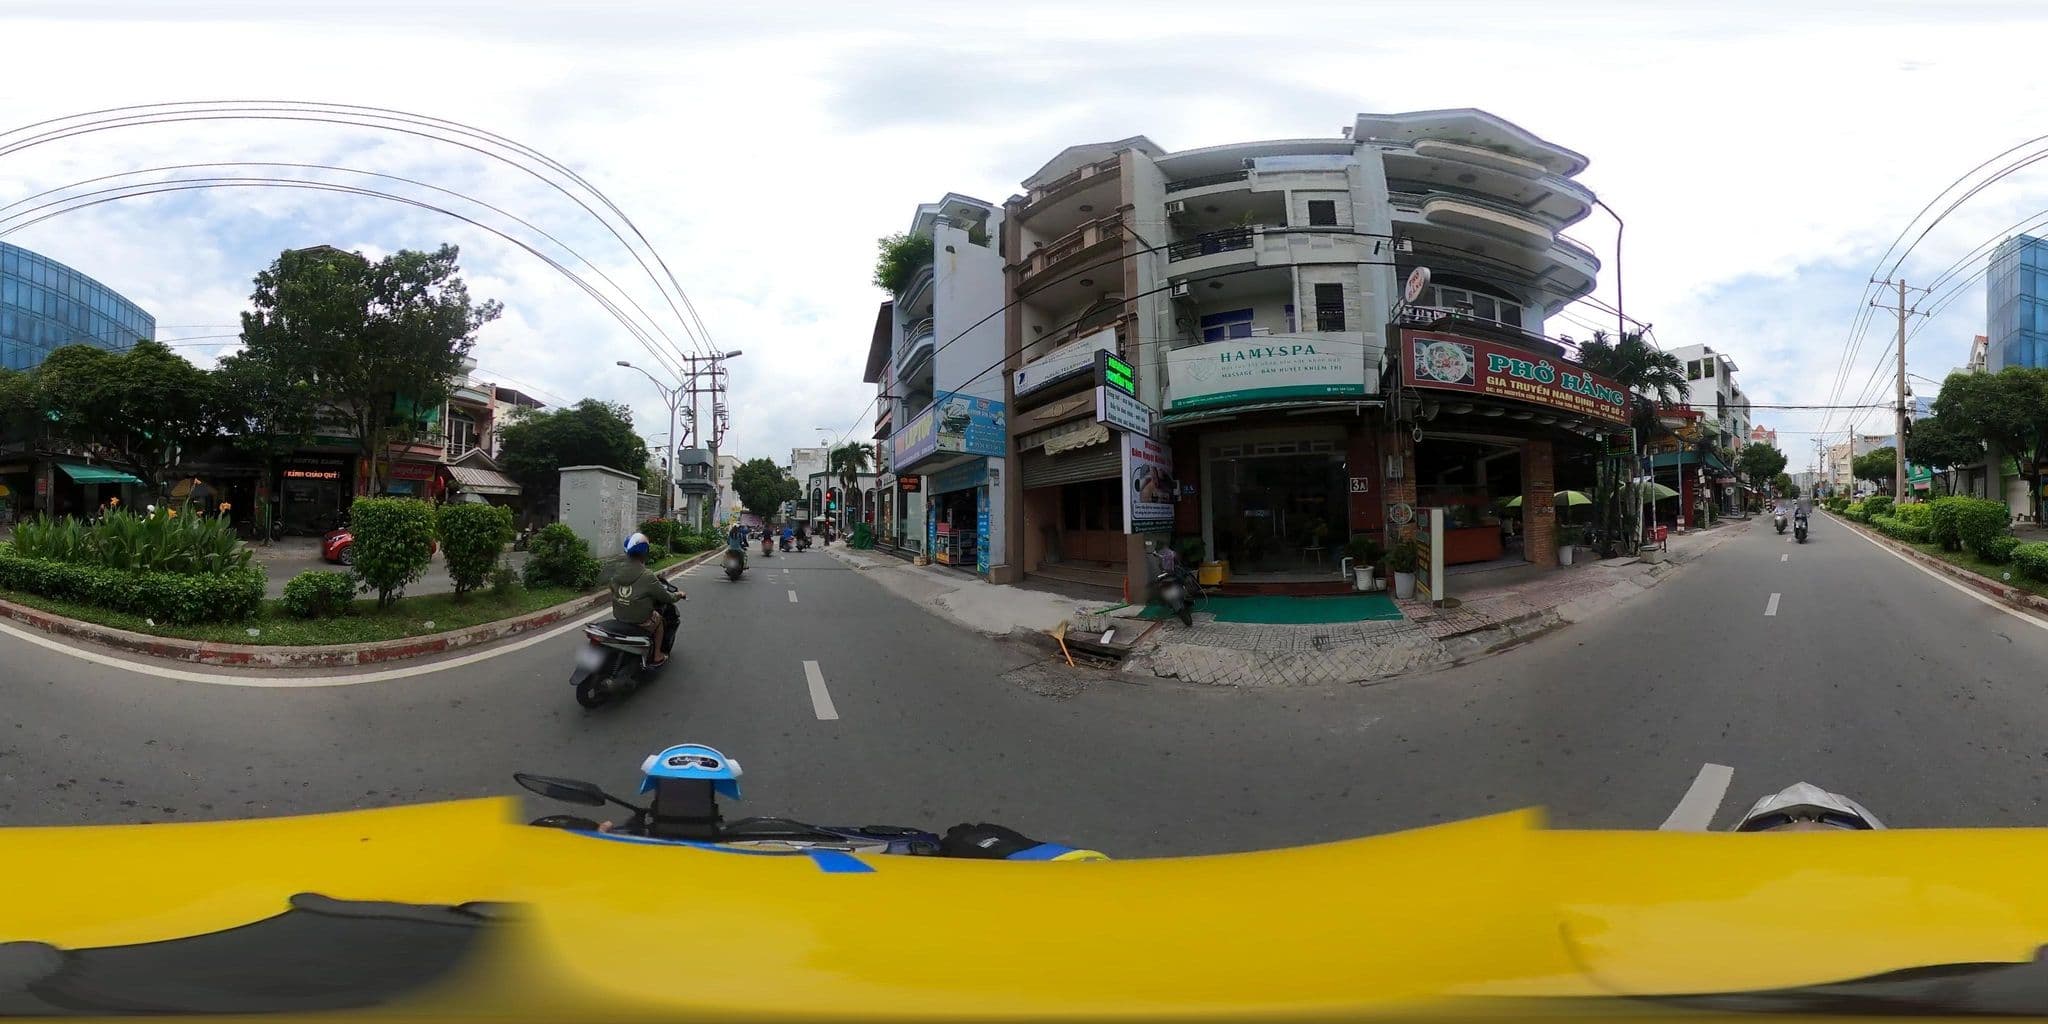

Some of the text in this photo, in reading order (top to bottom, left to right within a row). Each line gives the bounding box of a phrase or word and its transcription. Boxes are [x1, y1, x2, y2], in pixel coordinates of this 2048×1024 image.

[1220, 344, 1316, 362] HAMYSPA
[1222, 370, 1252, 378] MASSAGE
[1487, 353, 1625, 405] PHỞ HẰNG
[1487, 376, 1507, 388] GIA
[1510, 380, 1550, 396] TRUYỀN
[1552, 389, 1573, 402] NAM
[305, 470, 323, 478] CHÀO
[1352, 479, 1366, 491] 3A
